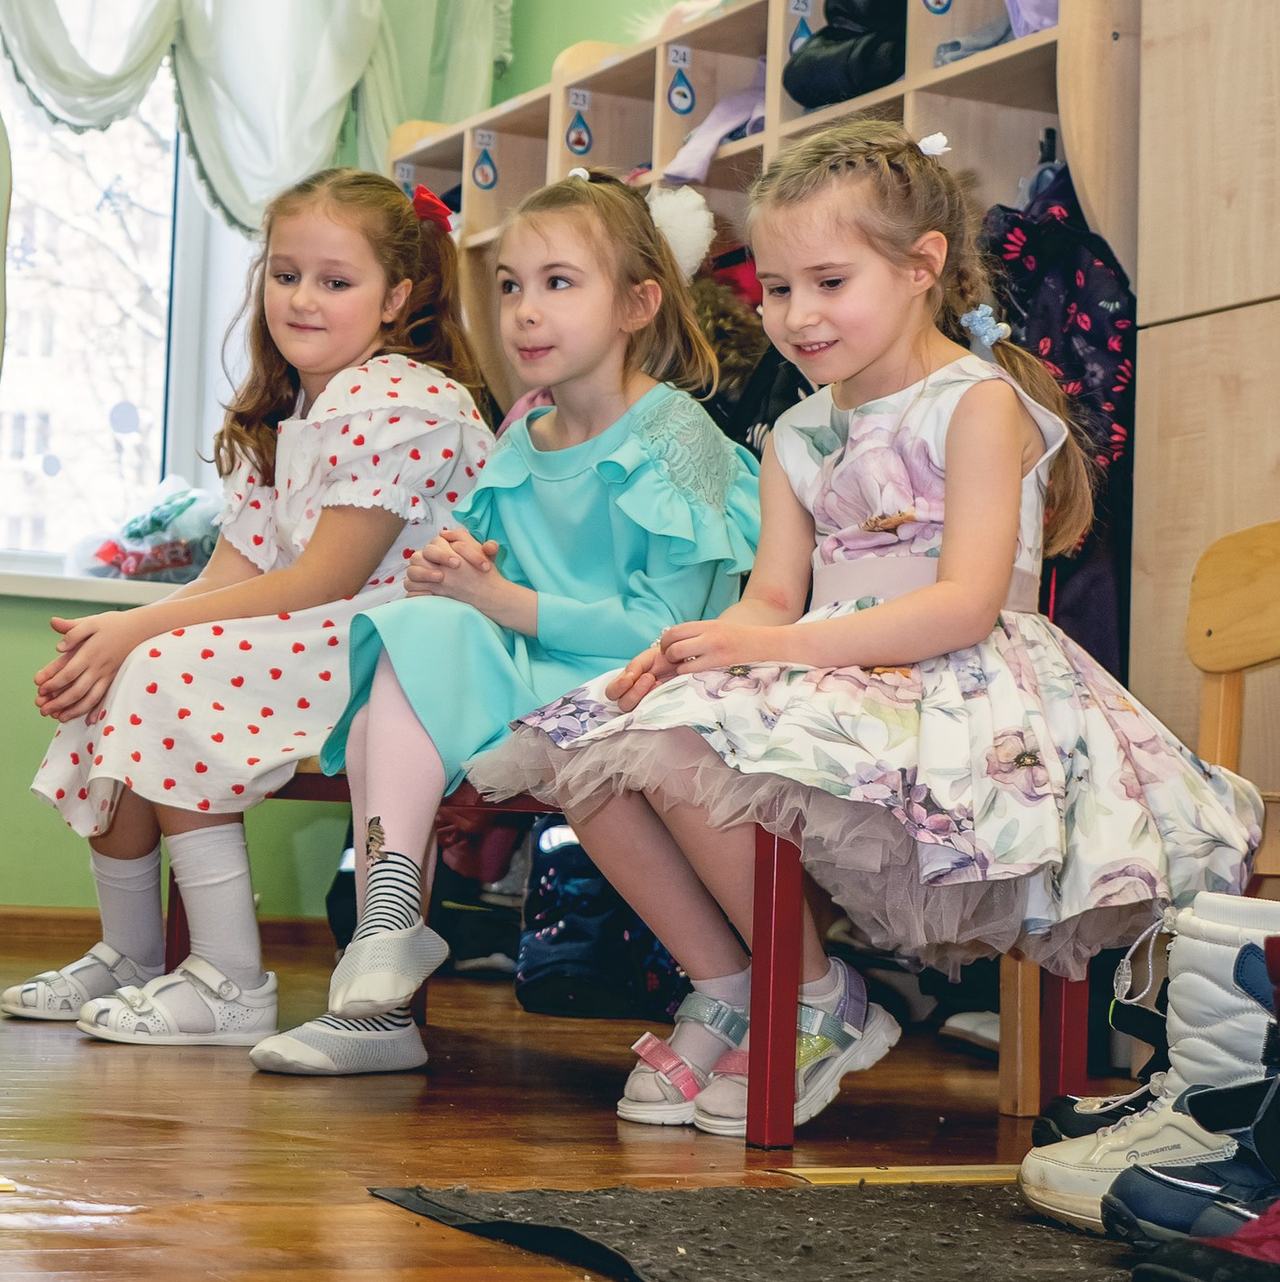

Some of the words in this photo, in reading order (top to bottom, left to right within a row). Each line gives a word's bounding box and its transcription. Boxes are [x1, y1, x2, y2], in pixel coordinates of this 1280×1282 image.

[671, 49, 689, 64] 24
[571, 92, 587, 106] 23
[478, 133, 493, 147] 22
[1140, 1143, 1182, 1157] OUTVENTURE
